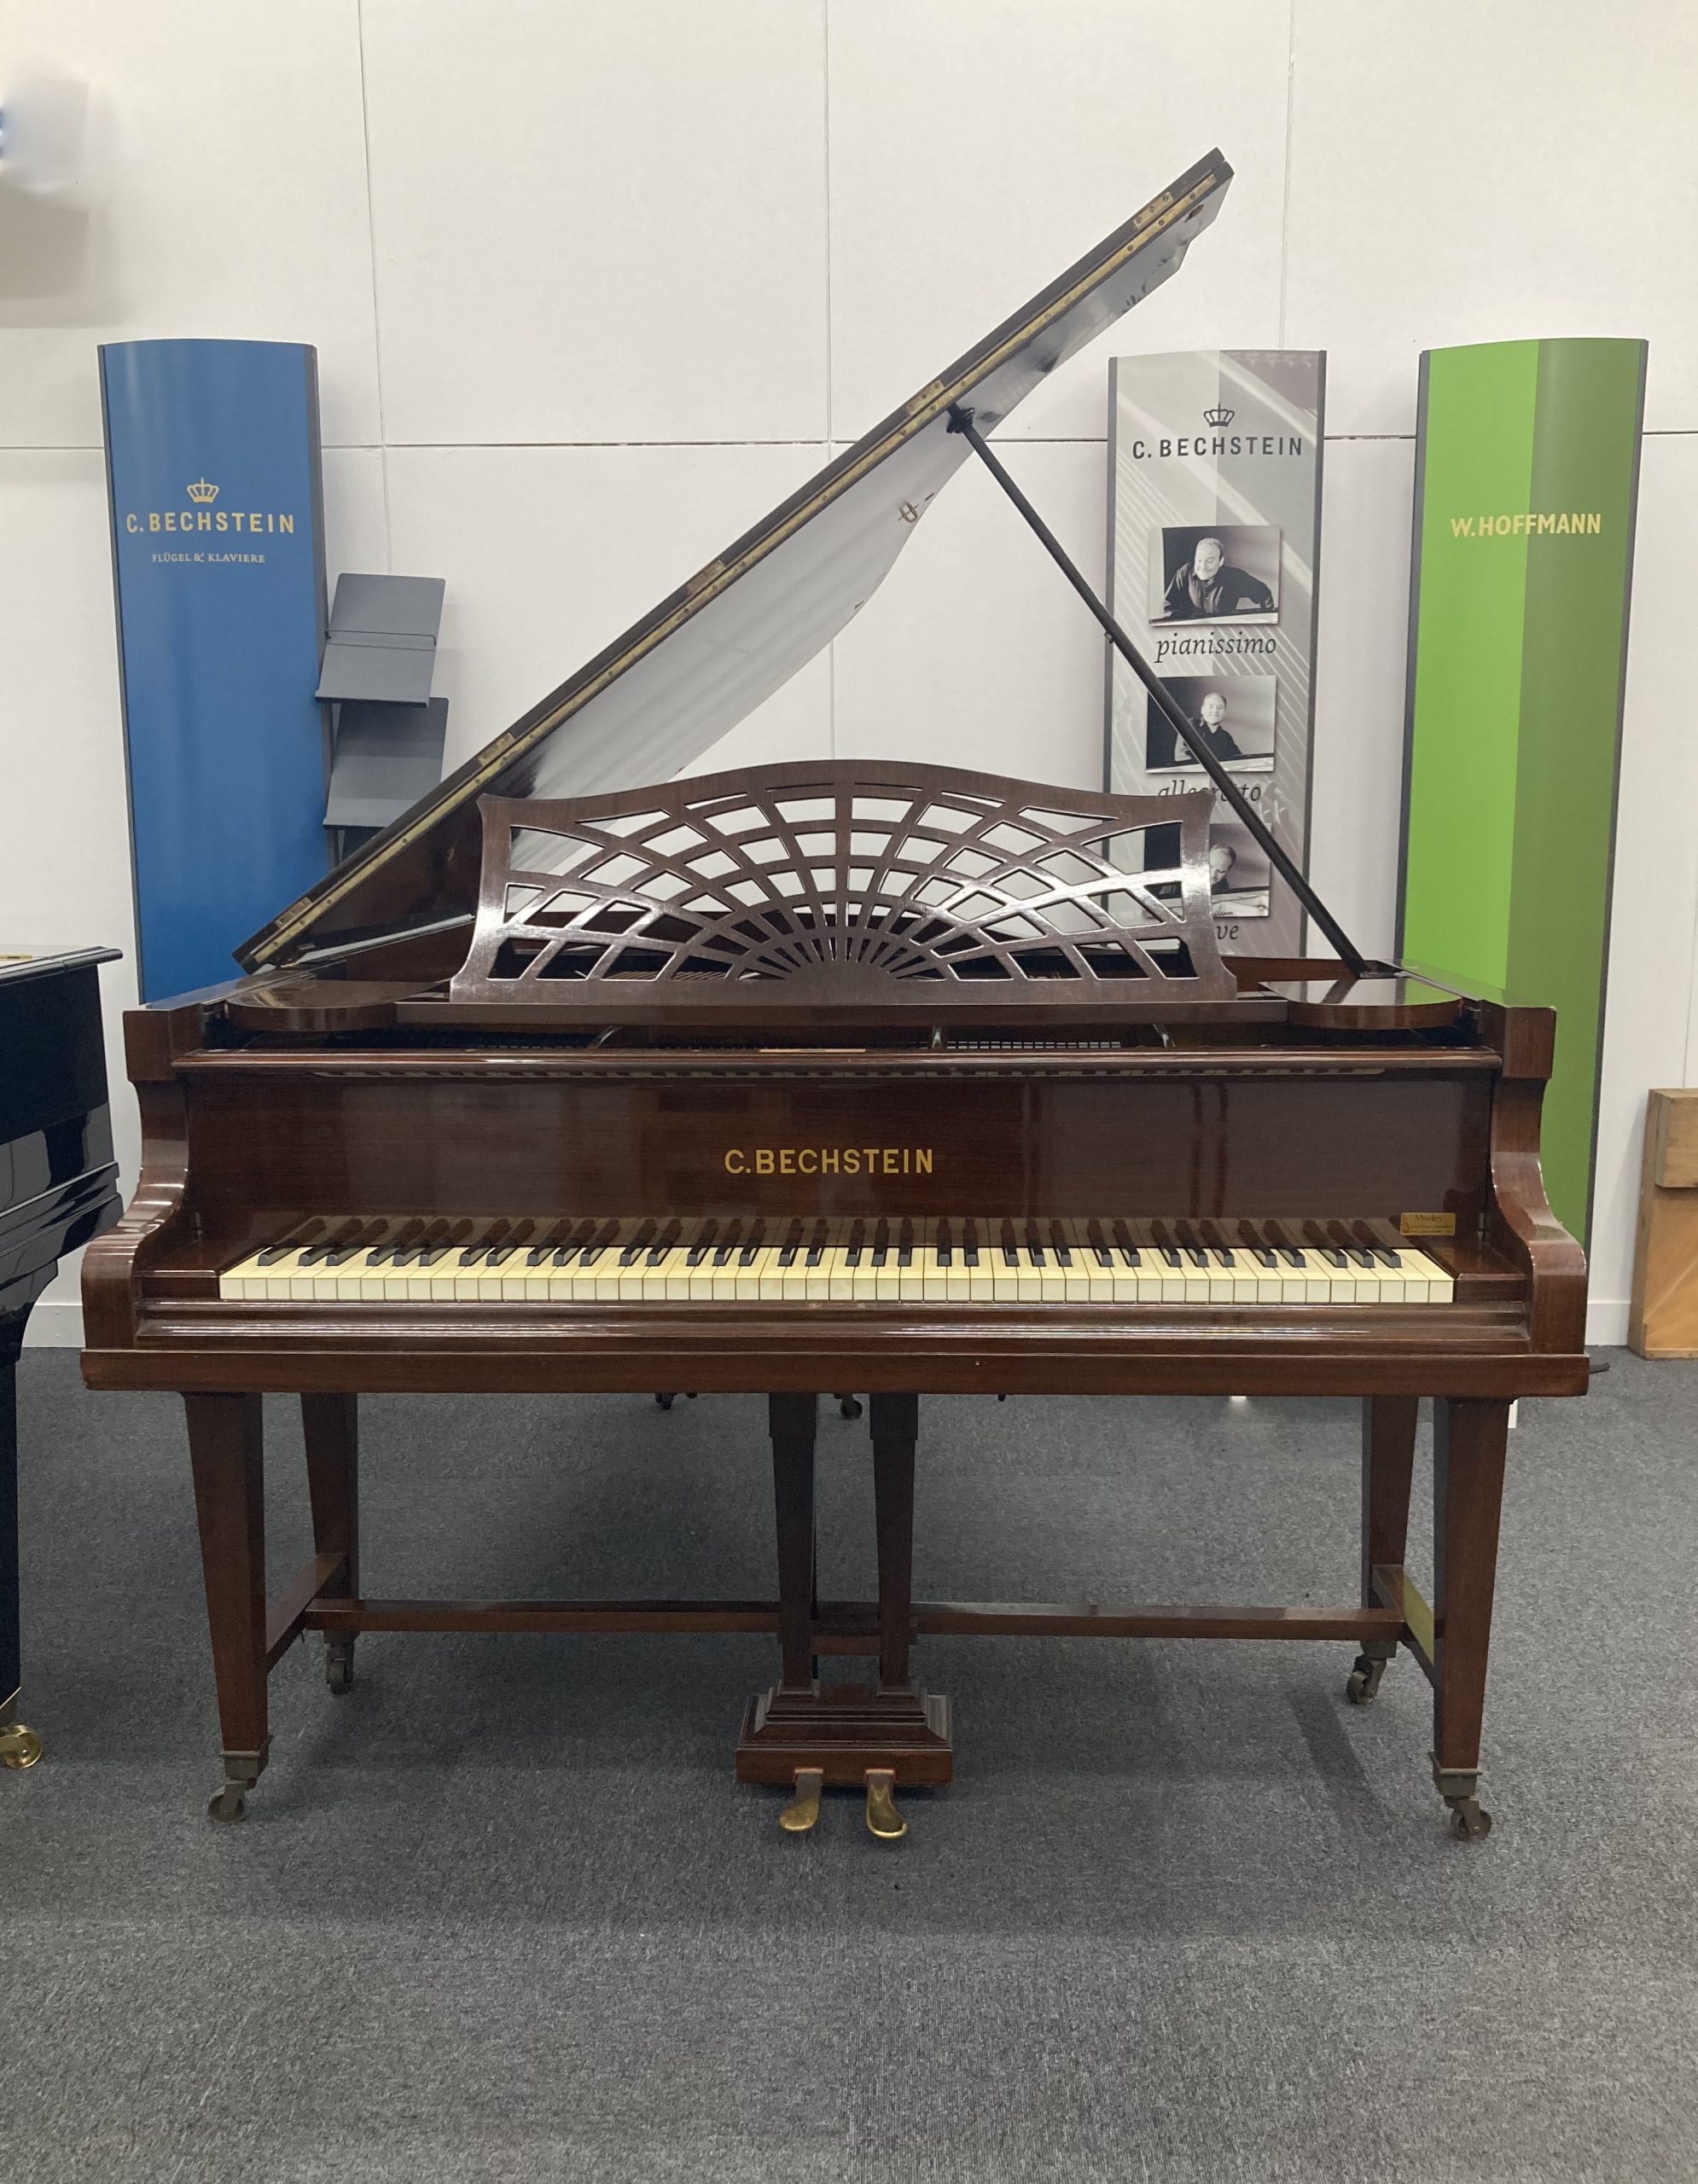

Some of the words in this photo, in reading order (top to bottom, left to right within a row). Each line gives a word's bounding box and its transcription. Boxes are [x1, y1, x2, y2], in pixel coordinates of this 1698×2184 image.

[1450, 513, 1602, 538] W.HOFFMANN
[152, 551, 192, 563] FLÜGEL
[194, 552, 205, 563] &
[207, 553, 265, 564] KLAVIERE
[1154, 630, 1277, 664] pianissimo
[1158, 779, 1262, 802] allrto
[724, 1148, 933, 1175] C.BECHSTEIN
